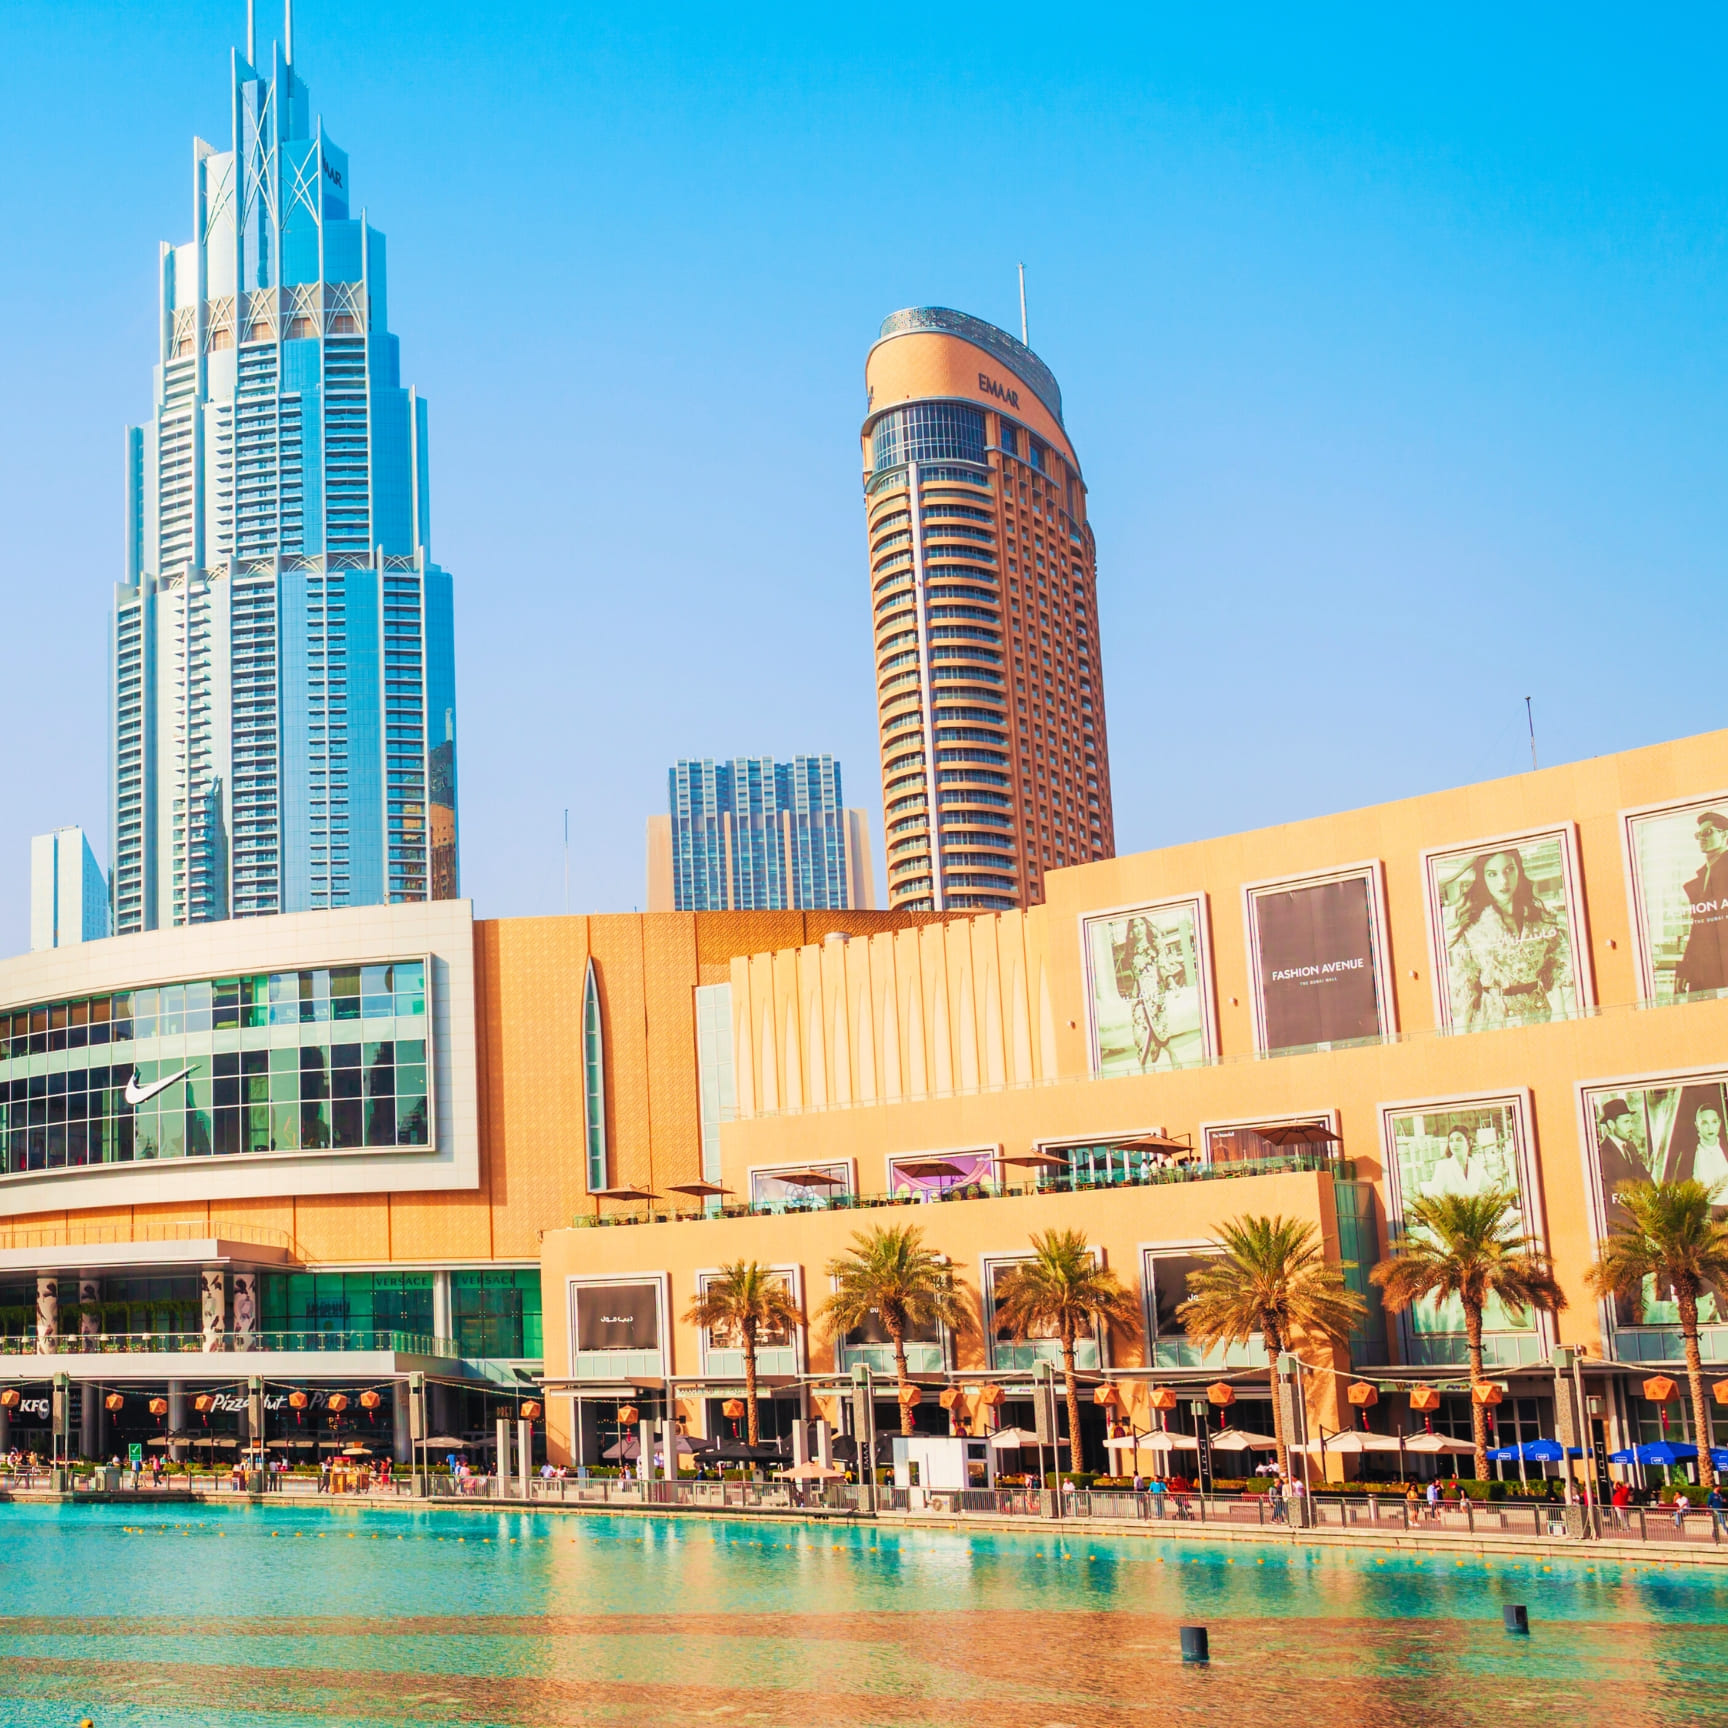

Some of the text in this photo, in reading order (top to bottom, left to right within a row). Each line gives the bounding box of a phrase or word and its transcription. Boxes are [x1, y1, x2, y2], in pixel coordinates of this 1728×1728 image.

[978, 372, 1020, 410] EMAAR
[1272, 958, 1364, 981] FASHION AVENUE
[375, 1277, 427, 1287] VERSACE
[19, 1399, 50, 1412] KFC
